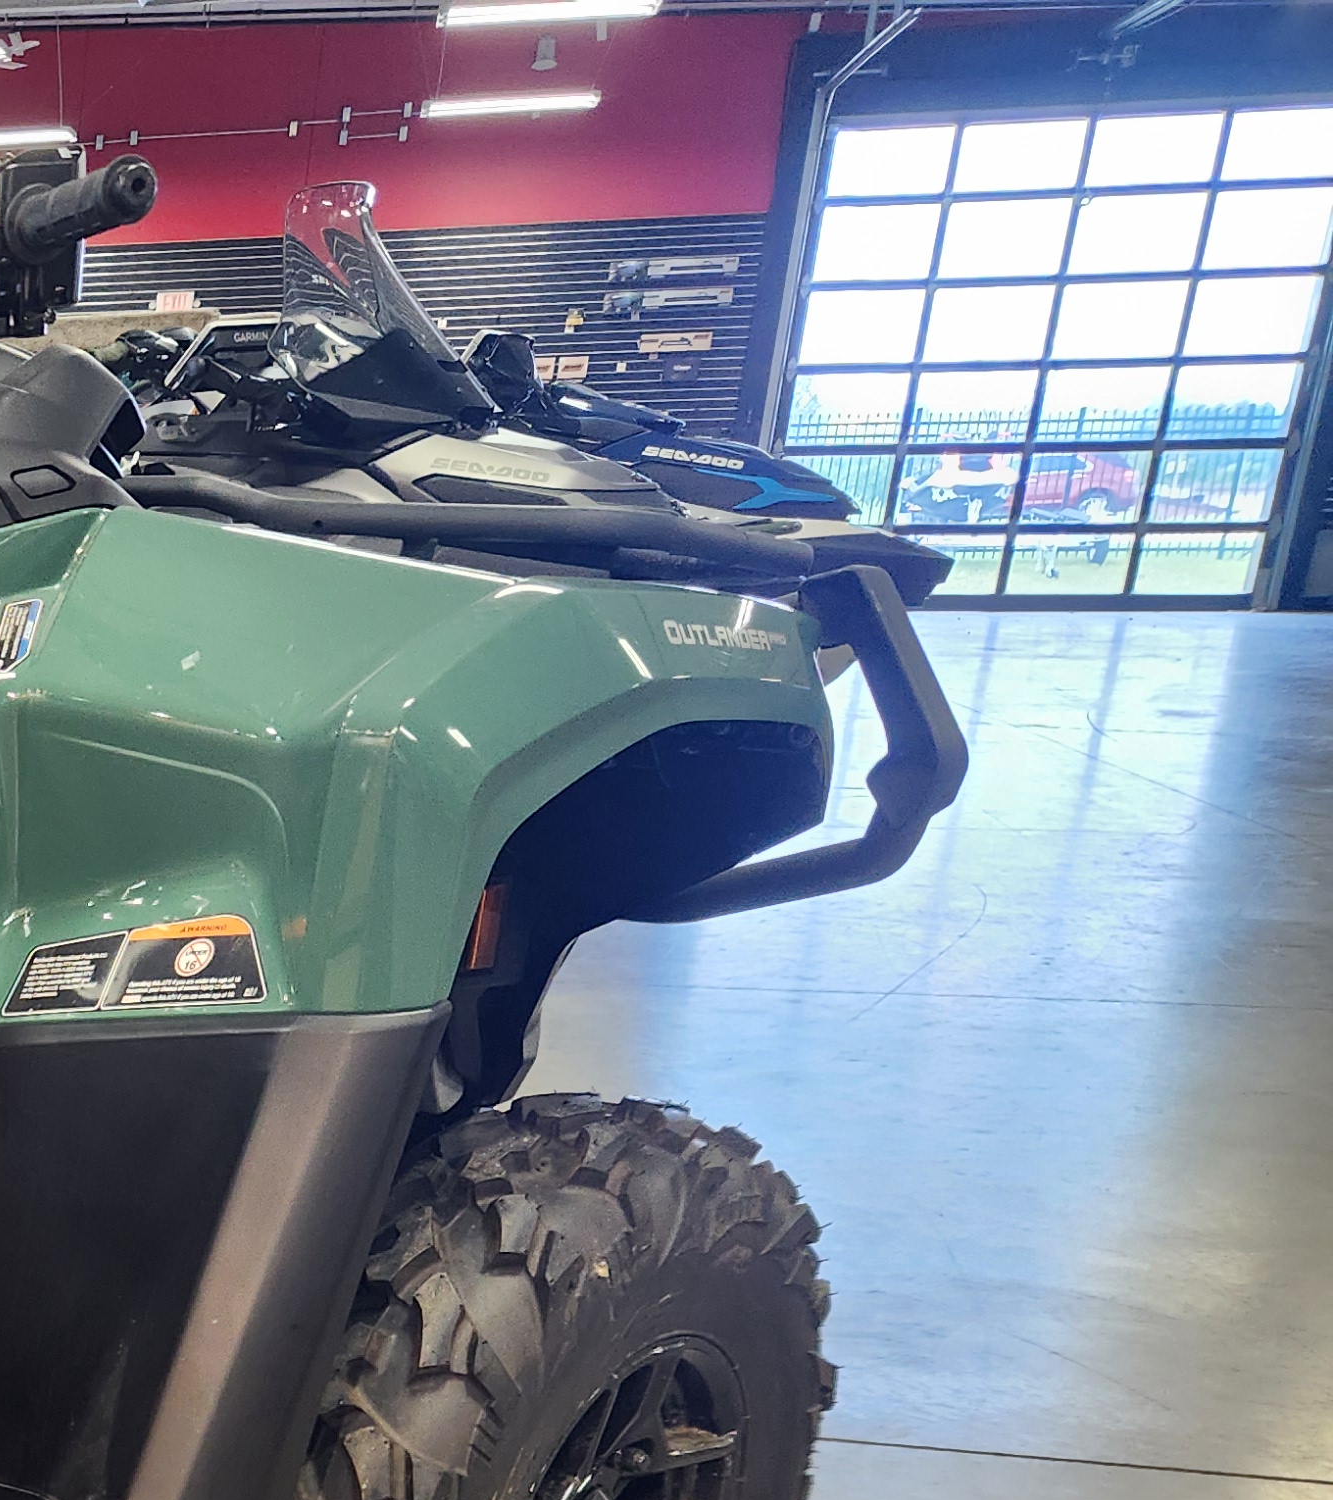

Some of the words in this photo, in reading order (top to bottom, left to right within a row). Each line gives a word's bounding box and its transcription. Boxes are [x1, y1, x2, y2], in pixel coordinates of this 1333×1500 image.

[162, 292, 190, 310] EXIT
[234, 330, 269, 343] GARMIN
[663, 619, 771, 651] OUTLANDER
[187, 923, 227, 934] WARNING
[184, 959, 196, 971] 16
